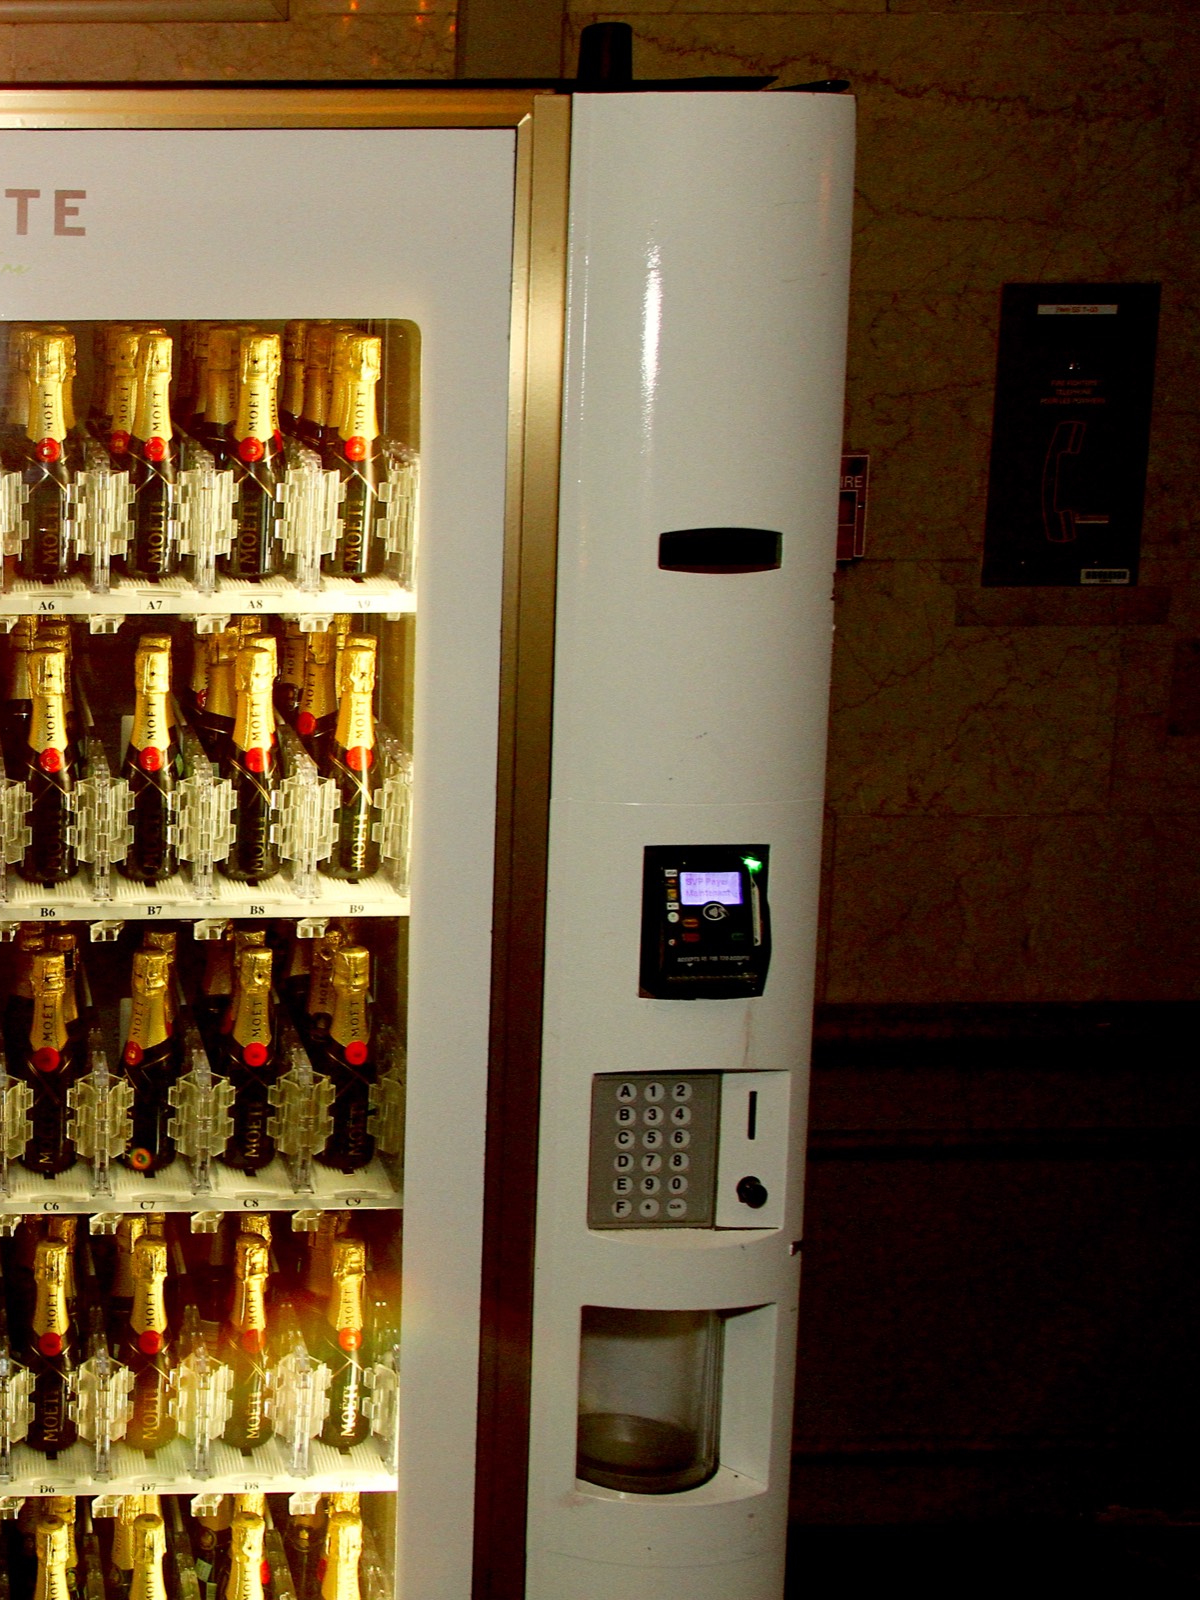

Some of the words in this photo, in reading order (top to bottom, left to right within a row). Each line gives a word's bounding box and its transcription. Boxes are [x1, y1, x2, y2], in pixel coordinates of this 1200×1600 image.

[840, 475, 864, 488] IRE
[39, 601, 54, 611] A6
[147, 601, 162, 611] A7
[247, 600, 263, 610] A8
[41, 908, 55, 918] B6
[148, 906, 162, 916] B7
[250, 906, 265, 915] B8
[350, 905, 364, 914] B9
[621, 1086, 631, 1097] A
[650, 1086, 656, 1096] 1
[677, 1085, 685, 1096] 2
[620, 1110, 630, 1120] B
[648, 1109, 656, 1120] 3
[676, 1109, 684, 1119] 4
[618, 1132, 629, 1144] C
[648, 1132, 656, 1143] 5
[675, 1132, 683, 1143] 6
[618, 1156, 628, 1167] D
[647, 1156, 654, 1166] 7
[674, 1155, 681, 1166] 8
[617, 1179, 626, 1190] E
[645, 1179, 654, 1190] 9
[672, 1179, 681, 1189] 0
[44, 1202, 59, 1211] C6
[140, 1201, 155, 1210] C7
[244, 1199, 259, 1208] C8
[346, 1197, 361, 1206] C9
[616, 1202, 625, 1213] F
[40, 1485, 55, 1494] D6
[142, 1483, 156, 1492] D7
